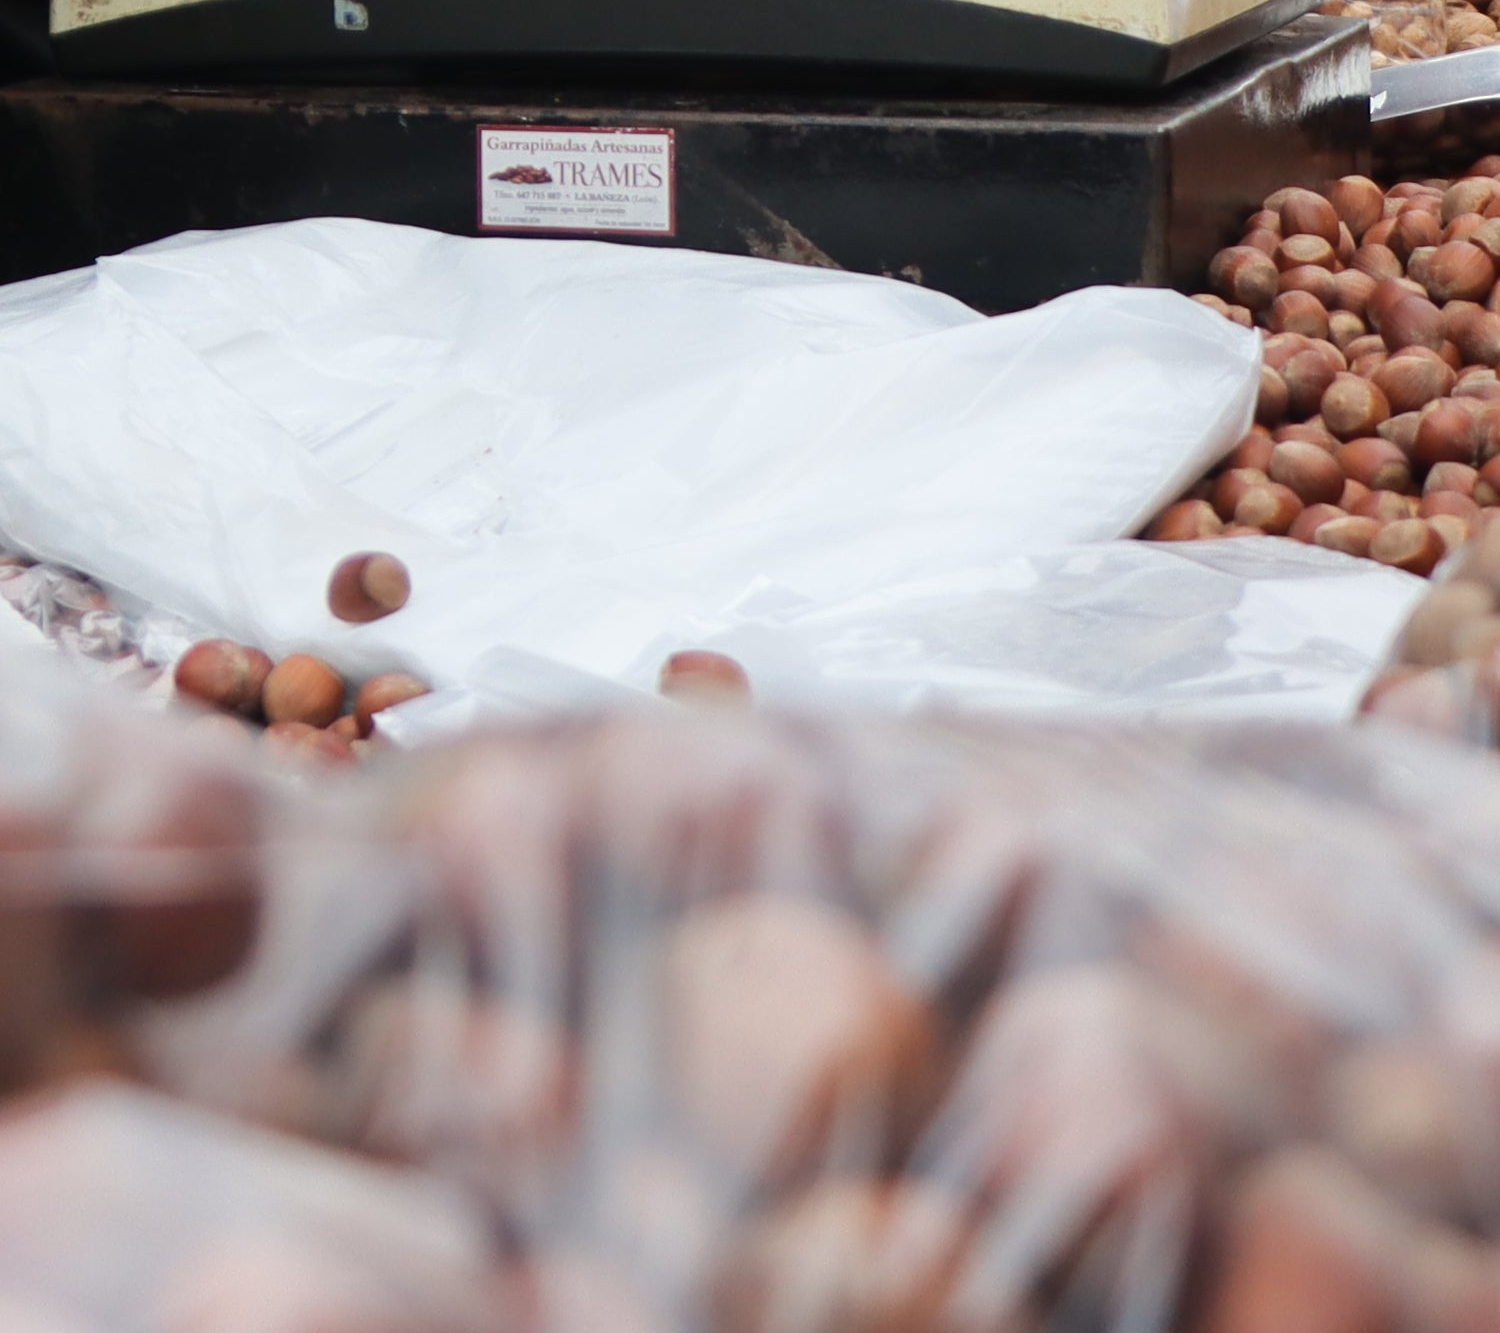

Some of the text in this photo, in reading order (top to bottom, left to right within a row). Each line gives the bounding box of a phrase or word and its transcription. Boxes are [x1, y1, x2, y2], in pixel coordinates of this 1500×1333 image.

[487, 136, 664, 155] Garrapiñadas Artesanas
[553, 161, 664, 189] TRAMES
